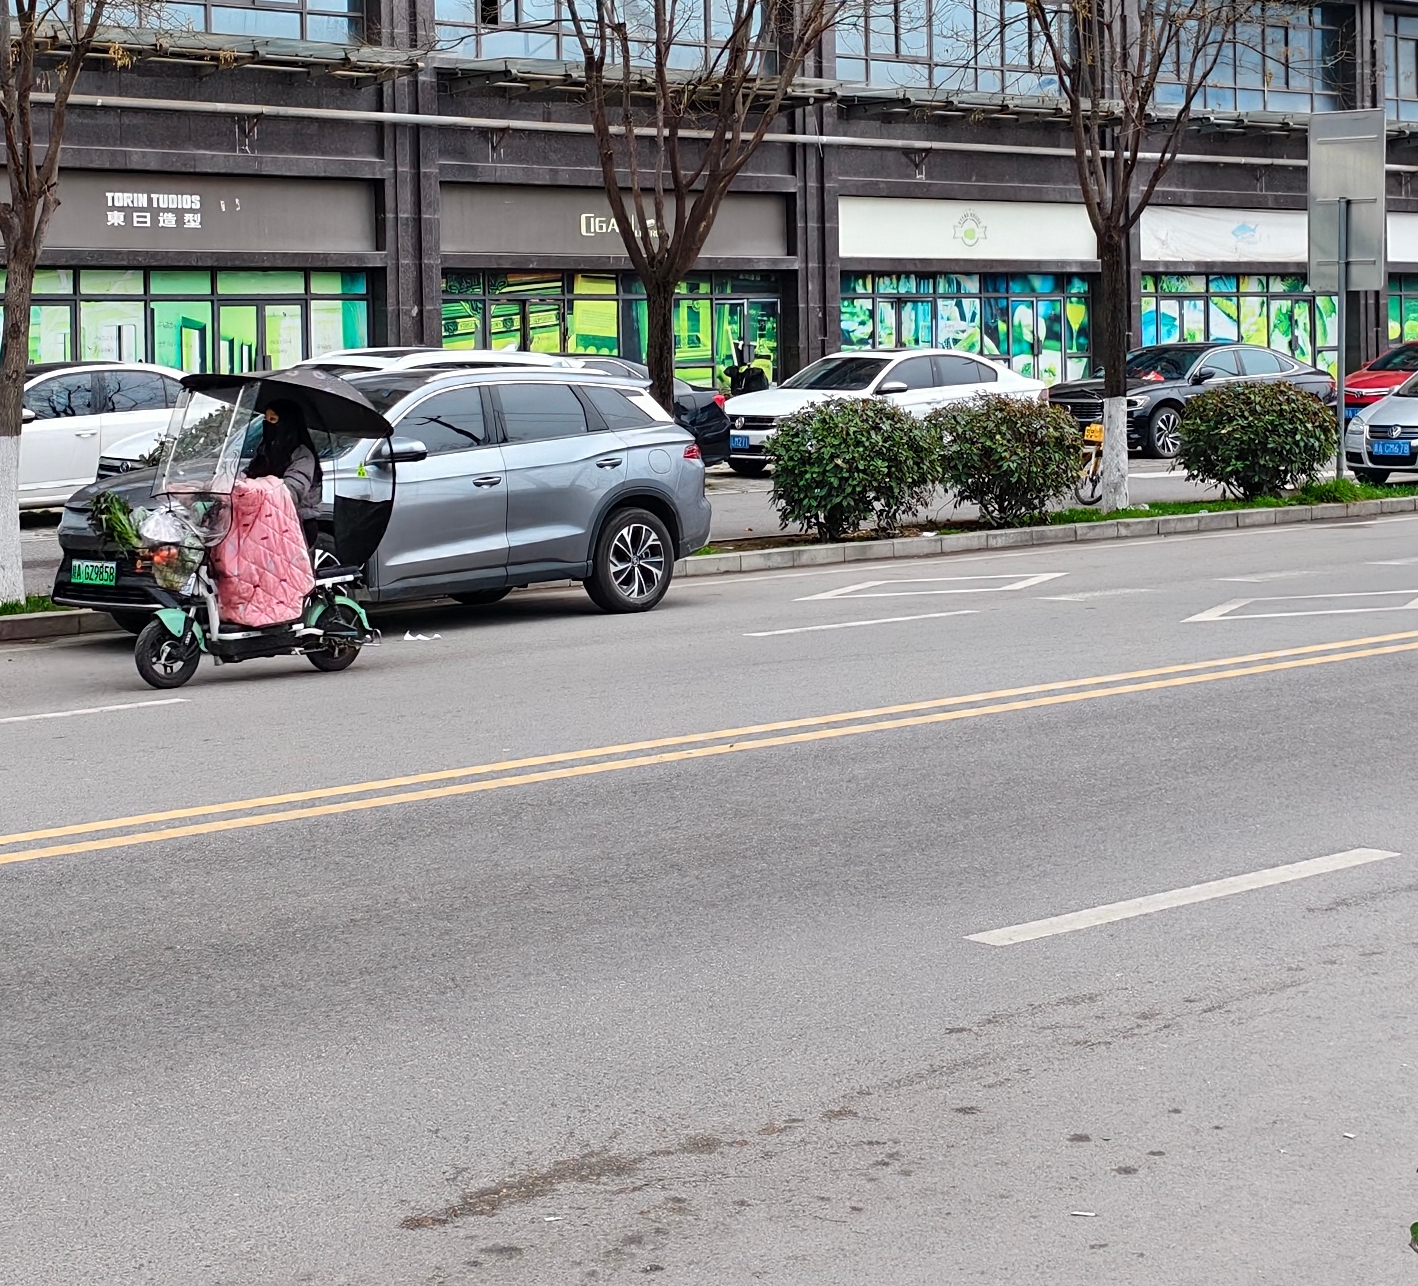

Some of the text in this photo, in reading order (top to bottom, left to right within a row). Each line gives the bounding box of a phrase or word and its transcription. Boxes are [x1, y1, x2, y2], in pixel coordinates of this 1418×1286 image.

[106, 192, 148, 208] TORIN
[151, 194, 201, 210] TUDIOS
[106, 211, 202, 229] 東日造型
[580, 213, 623, 237] CIGA
